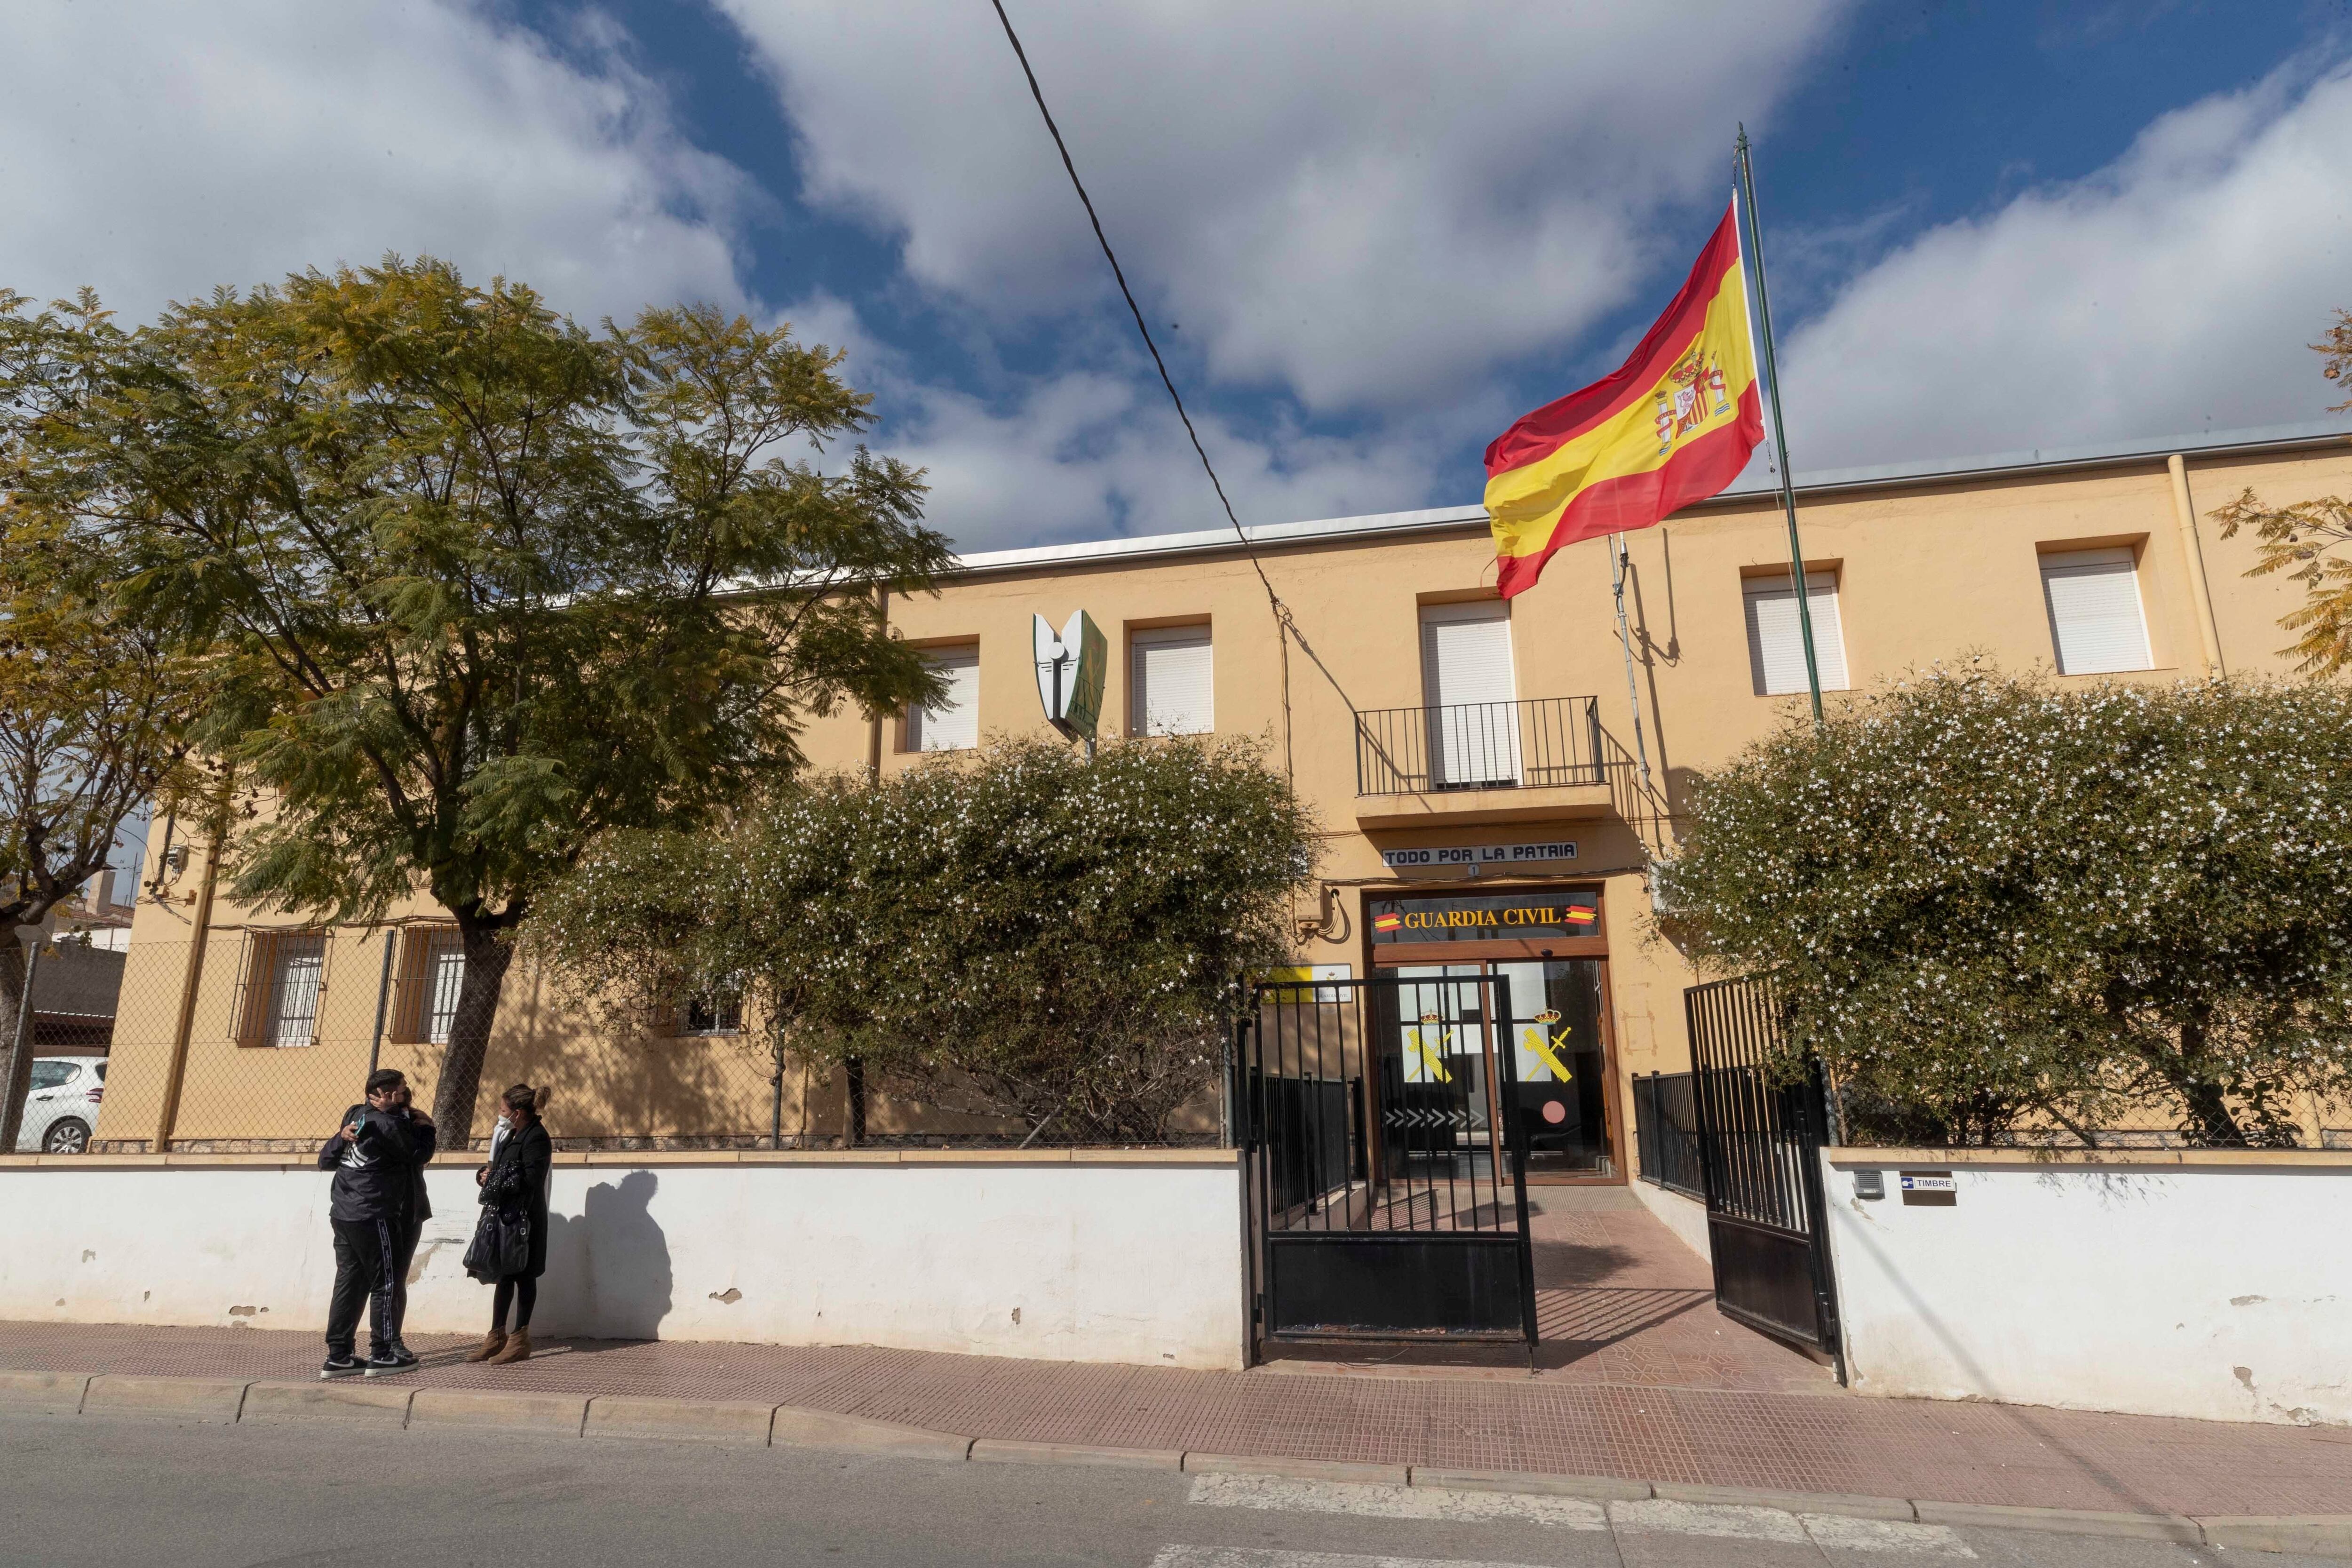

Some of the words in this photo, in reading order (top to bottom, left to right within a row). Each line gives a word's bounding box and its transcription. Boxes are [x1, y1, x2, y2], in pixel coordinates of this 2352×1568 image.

[1385, 851, 1430, 864] TODO
[1438, 849, 1473, 862] POR
[1482, 847, 1505, 860] LA
[1513, 844, 1575, 859] PATRIA
[1471, 866, 1476, 875] 1
[1404, 910, 1499, 929] GUARDIA
[1503, 907, 1561, 925] CIVIL
